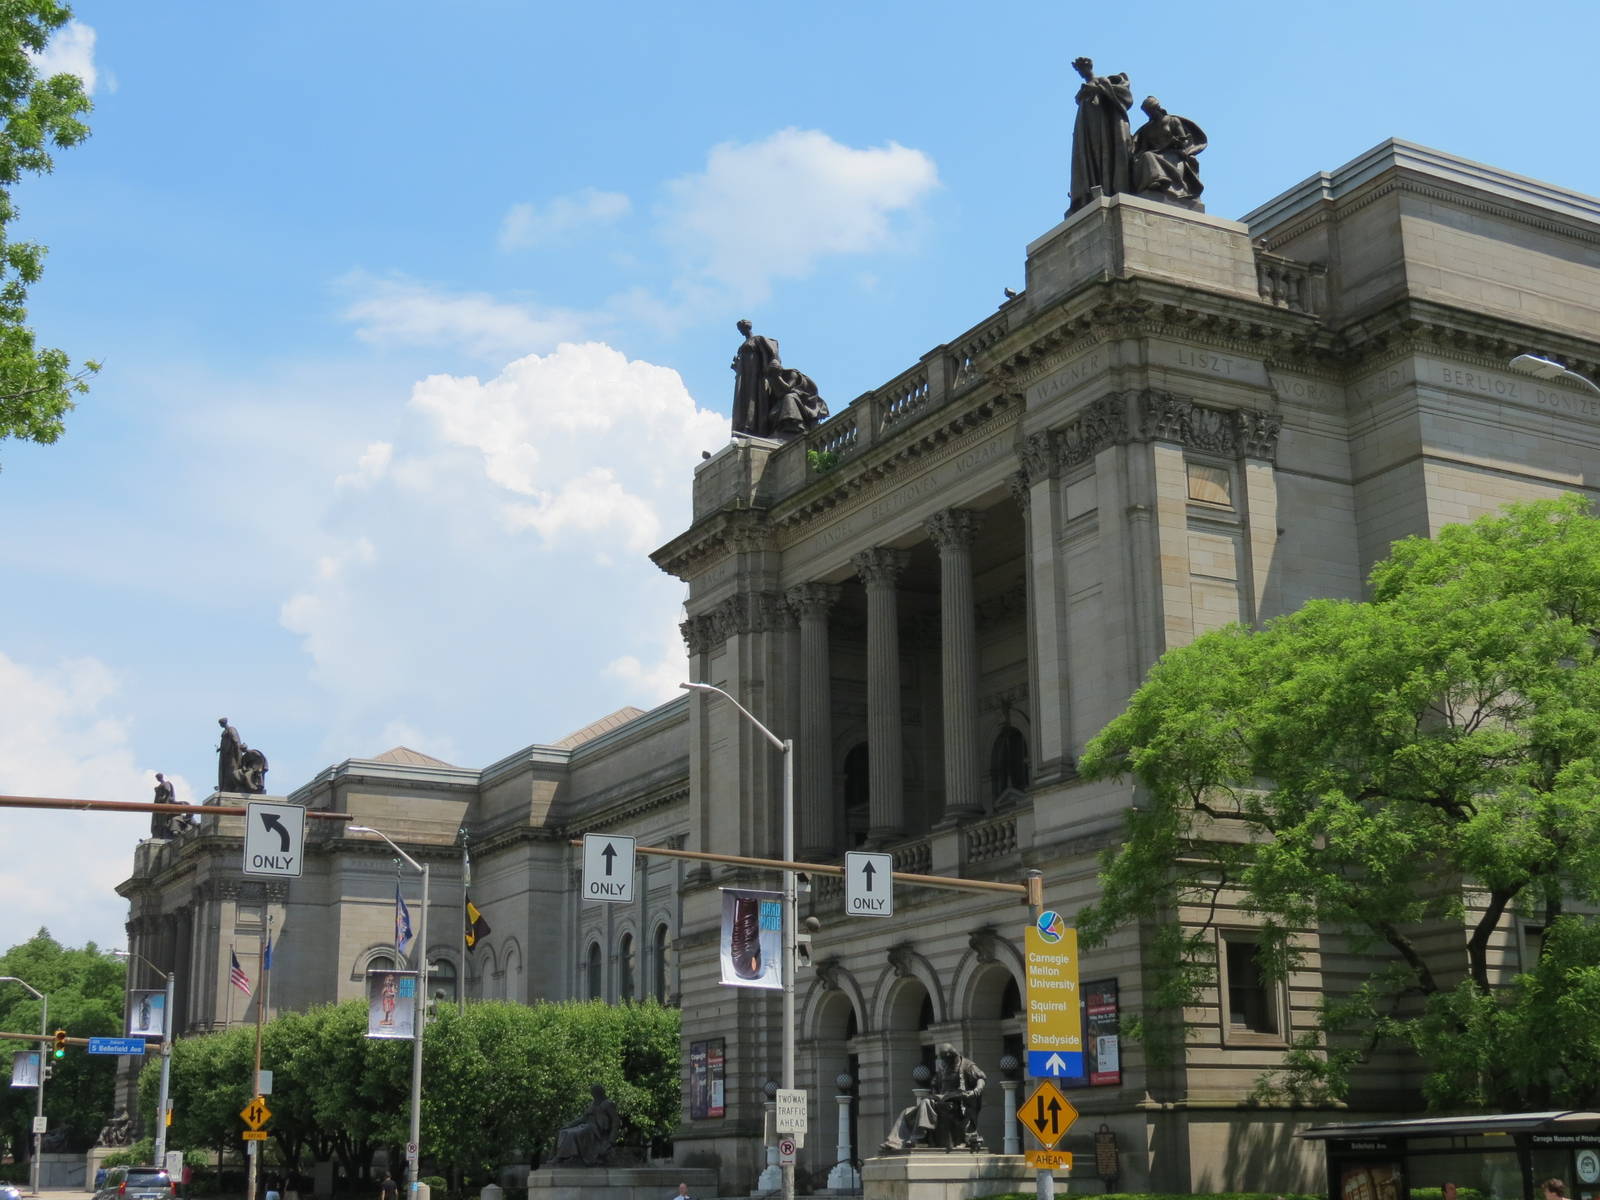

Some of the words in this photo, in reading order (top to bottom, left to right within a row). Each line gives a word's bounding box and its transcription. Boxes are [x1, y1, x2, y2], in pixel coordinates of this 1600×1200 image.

[1176, 348, 1234, 375] LISZT
[1036, 354, 1100, 400] WAGNER
[1442, 368, 1519, 398] BERLIOZ
[1536, 389, 1600, 419] DONIZE
[253, 854, 293, 870] ONLY
[590, 881, 626, 896] ONLY
[760, 903, 781, 917] HAND
[853, 897, 885, 910] ONLY
[760, 916, 781, 931] MADE
[1029, 952, 1070, 965] Carnegie
[1029, 965, 1060, 976] Mellon
[1030, 978, 1076, 992] University
[1030, 1000, 1067, 1012] Squirrel
[1031, 1013, 1047, 1023] Hill
[1031, 1034, 1080, 1047] Shadyside
[778, 1096, 792, 1104] TWO
[792, 1096, 805, 1104] WAY
[778, 1107, 806, 1116] TRAFFIC
[779, 1119, 805, 1128] AHEAD
[1036, 1154, 1064, 1165] AHEAD
